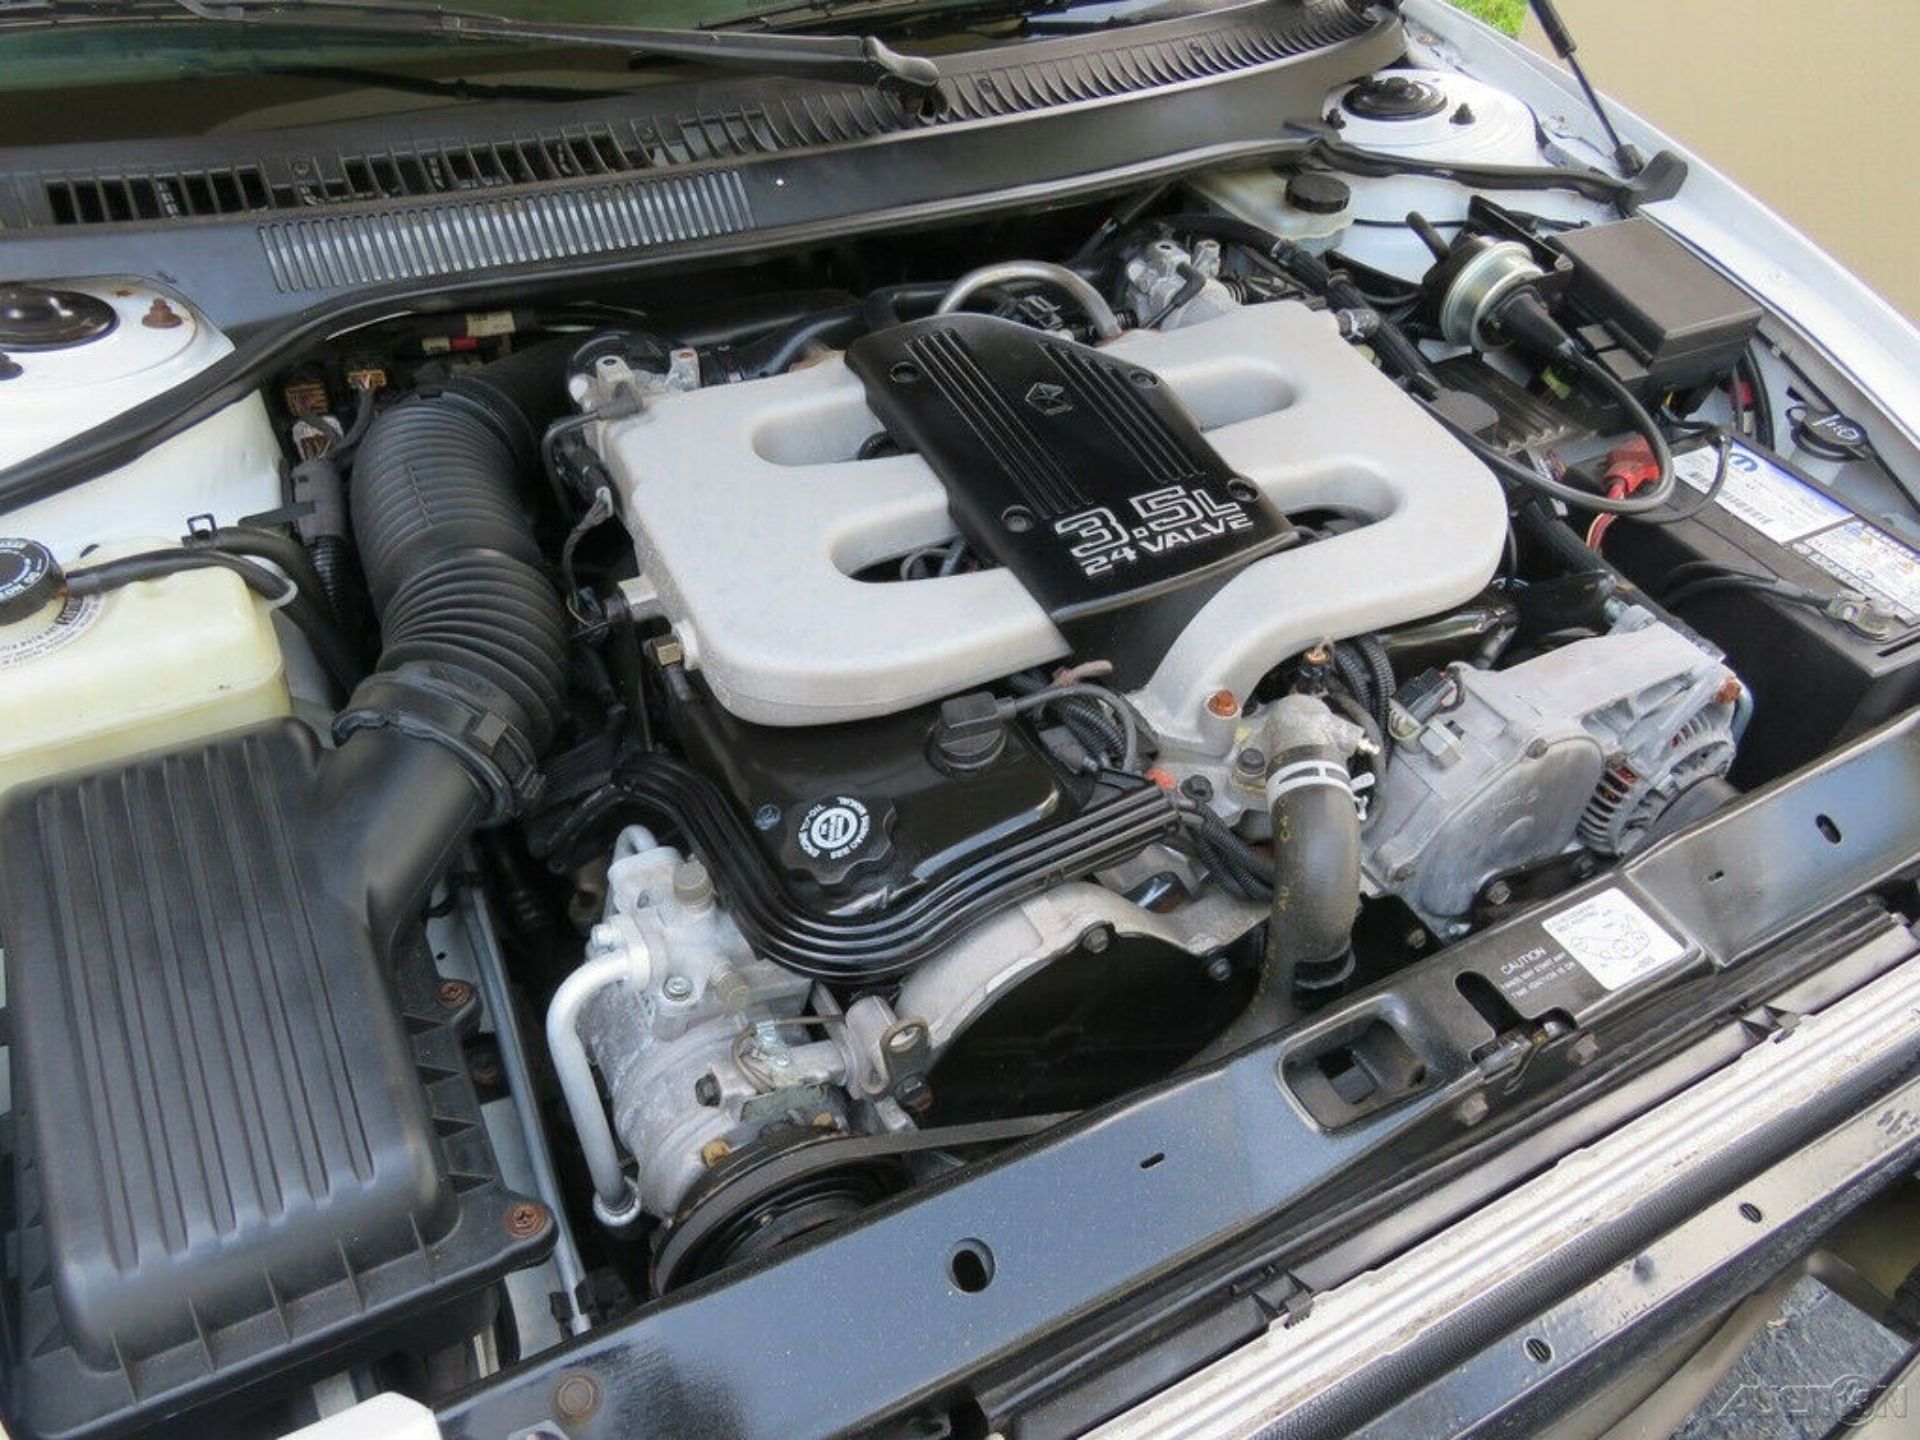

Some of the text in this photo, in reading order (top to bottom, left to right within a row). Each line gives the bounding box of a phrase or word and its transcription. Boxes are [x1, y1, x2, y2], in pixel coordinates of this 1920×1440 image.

[1054, 485, 1241, 558] 3.5L
[1080, 512, 1253, 577] 24 VALVE
[1501, 946, 1547, 974] CAUTION
